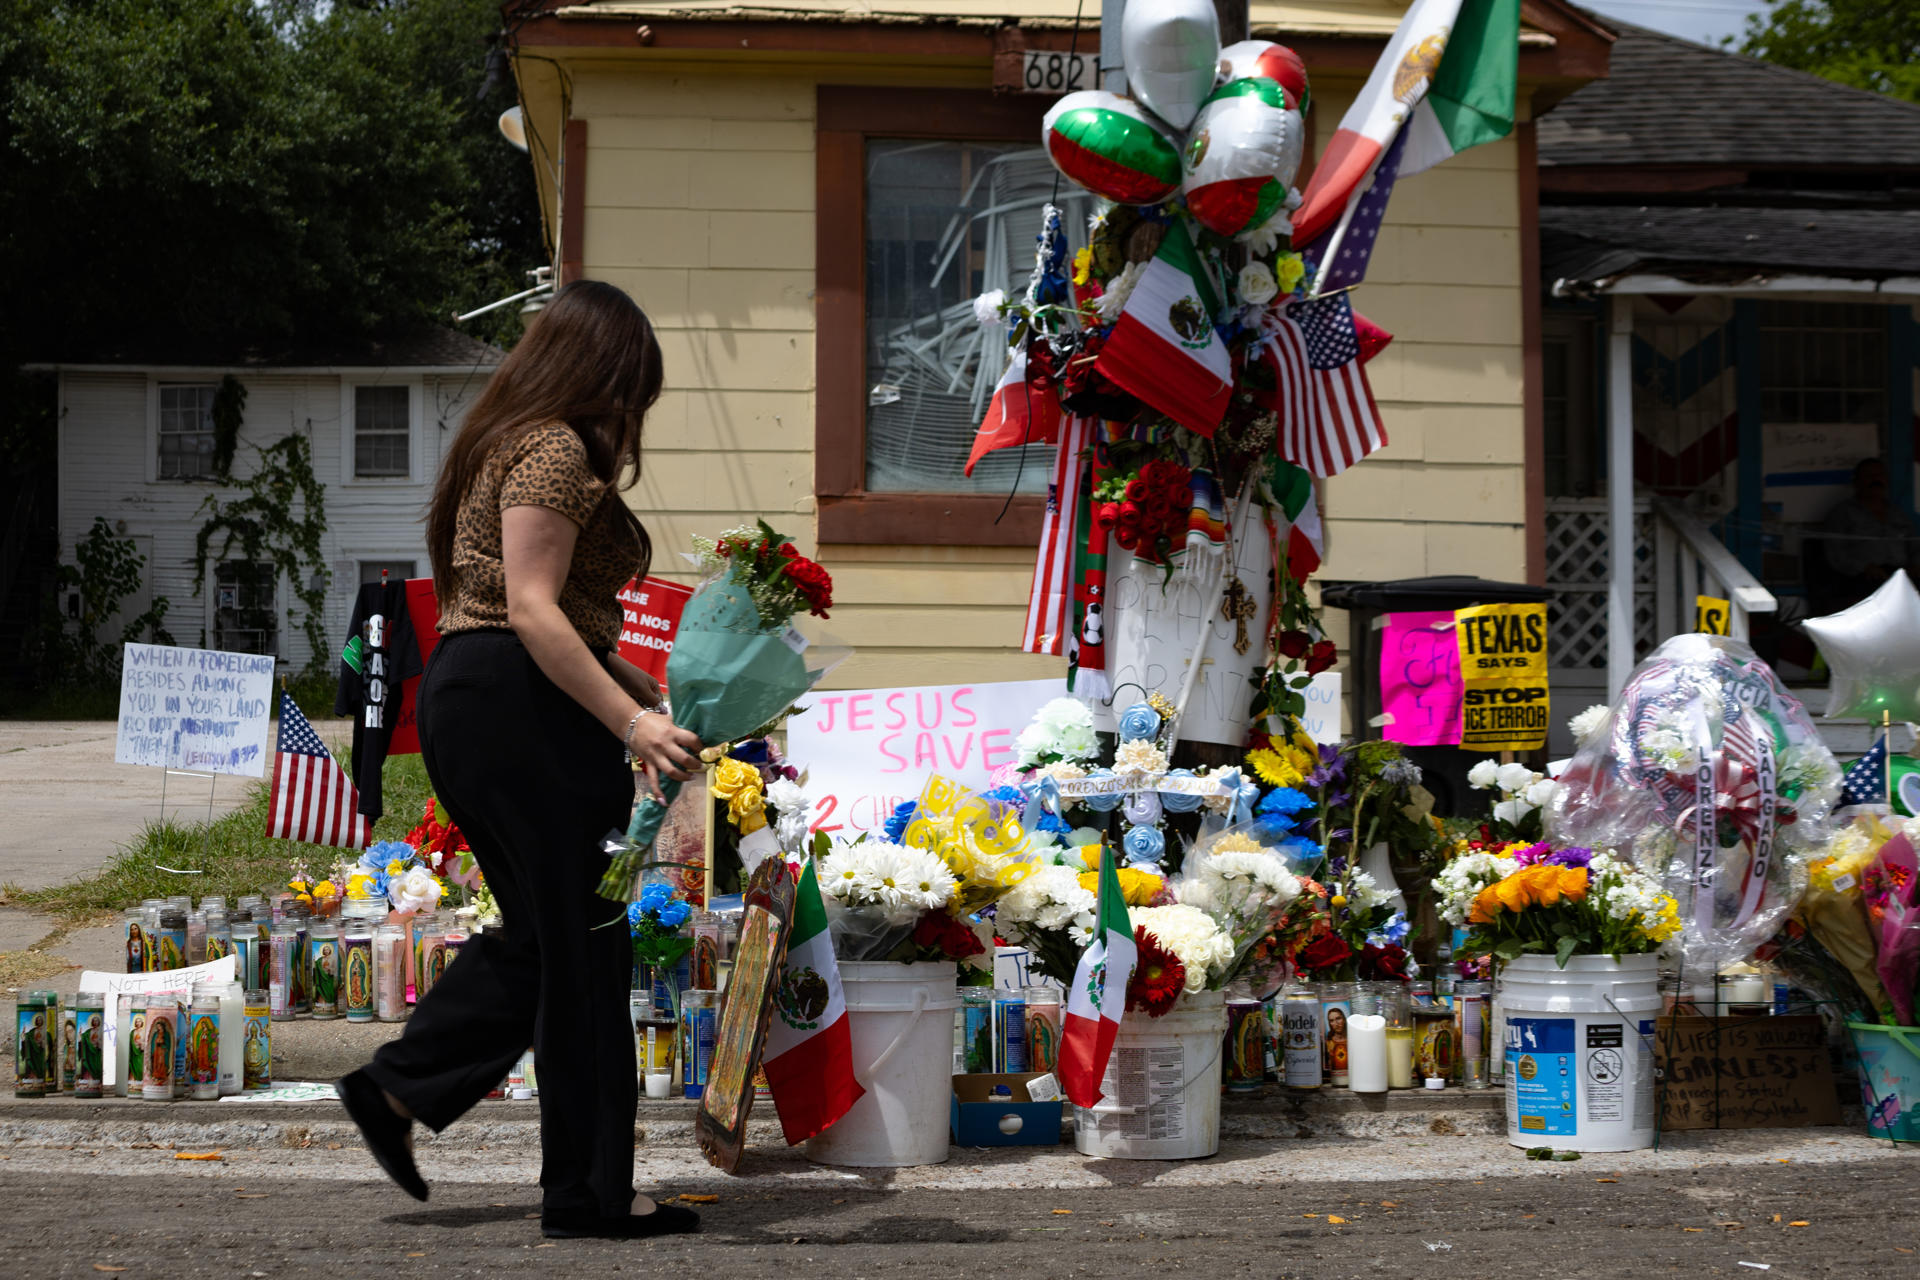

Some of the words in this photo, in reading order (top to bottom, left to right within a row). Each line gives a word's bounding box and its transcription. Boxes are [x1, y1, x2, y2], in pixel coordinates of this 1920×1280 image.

[1026, 53, 1100, 89] 6821
[640, 613, 671, 631] NOS
[1460, 613, 1542, 655] TEXAS
[619, 629, 674, 653] ASIADO
[130, 648, 183, 668] WHEN
[188, 650, 196, 667] A
[199, 651, 273, 674] FOREIGNER
[1477, 657, 1528, 668] SAYS
[126, 669, 186, 691] RESIDES
[192, 674, 247, 695] AMONG
[128, 693, 156, 714] YOU
[165, 696, 180, 713] IN
[187, 696, 222, 715] YOUR
[229, 697, 265, 718] LAND
[1465, 687, 1546, 705] STOP
[817, 688, 977, 733] JESUS
[1465, 709, 1487, 731] ICE
[1490, 706, 1546, 730] TERROR
[879, 728, 1020, 773] SAVE
[809, 795, 844, 834] 2
[1754, 738, 1772, 878] SALGADO
[109, 978, 148, 992] NOT
[163, 970, 207, 990] HERE
[1729, 1030, 1748, 1047] IS
